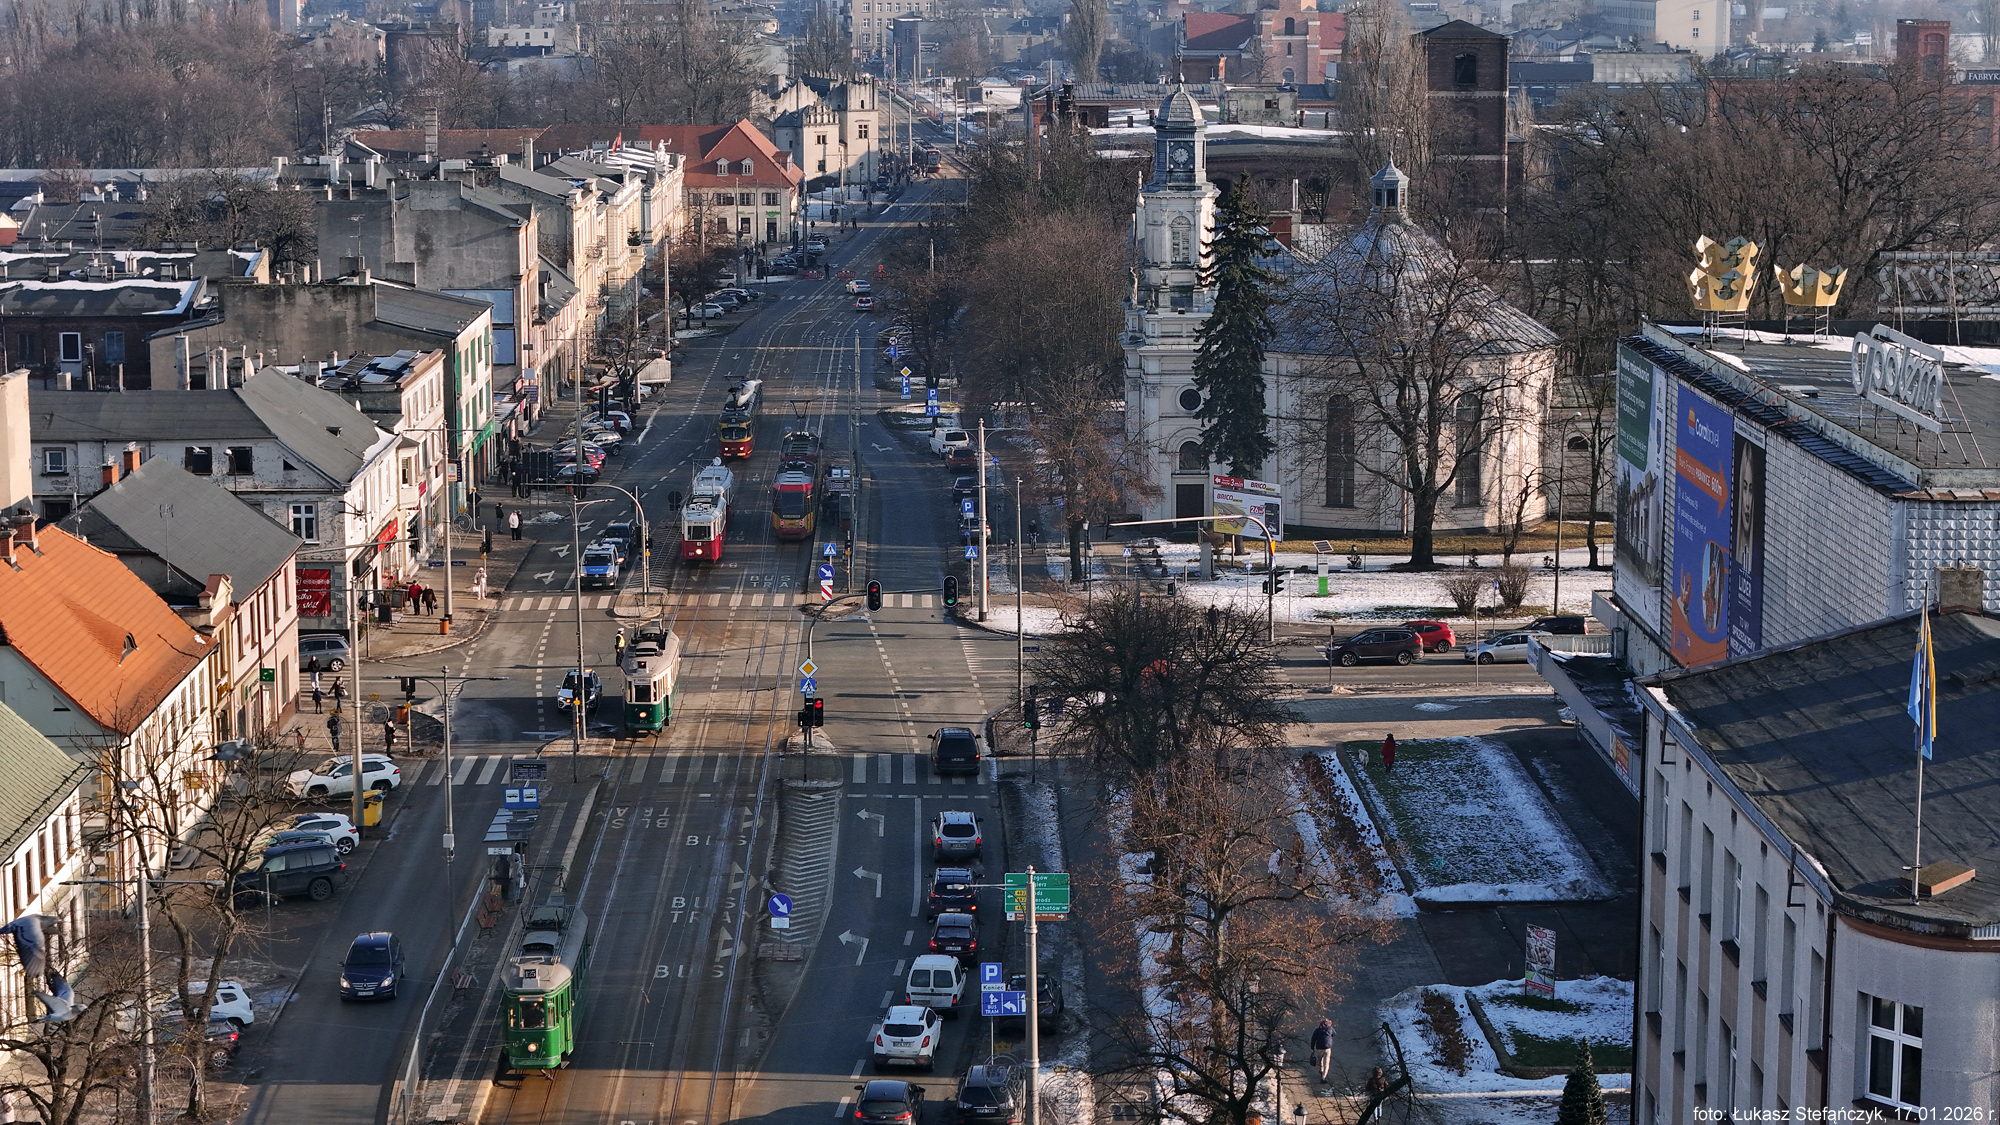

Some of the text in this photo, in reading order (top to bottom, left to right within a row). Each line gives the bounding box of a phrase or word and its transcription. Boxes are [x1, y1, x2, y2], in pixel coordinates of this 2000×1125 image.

[1968, 72, 2000, 80] FABRYK
[1217, 493, 1234, 501] BRICO
[965, 502, 972, 511] P
[985, 965, 998, 981] P
